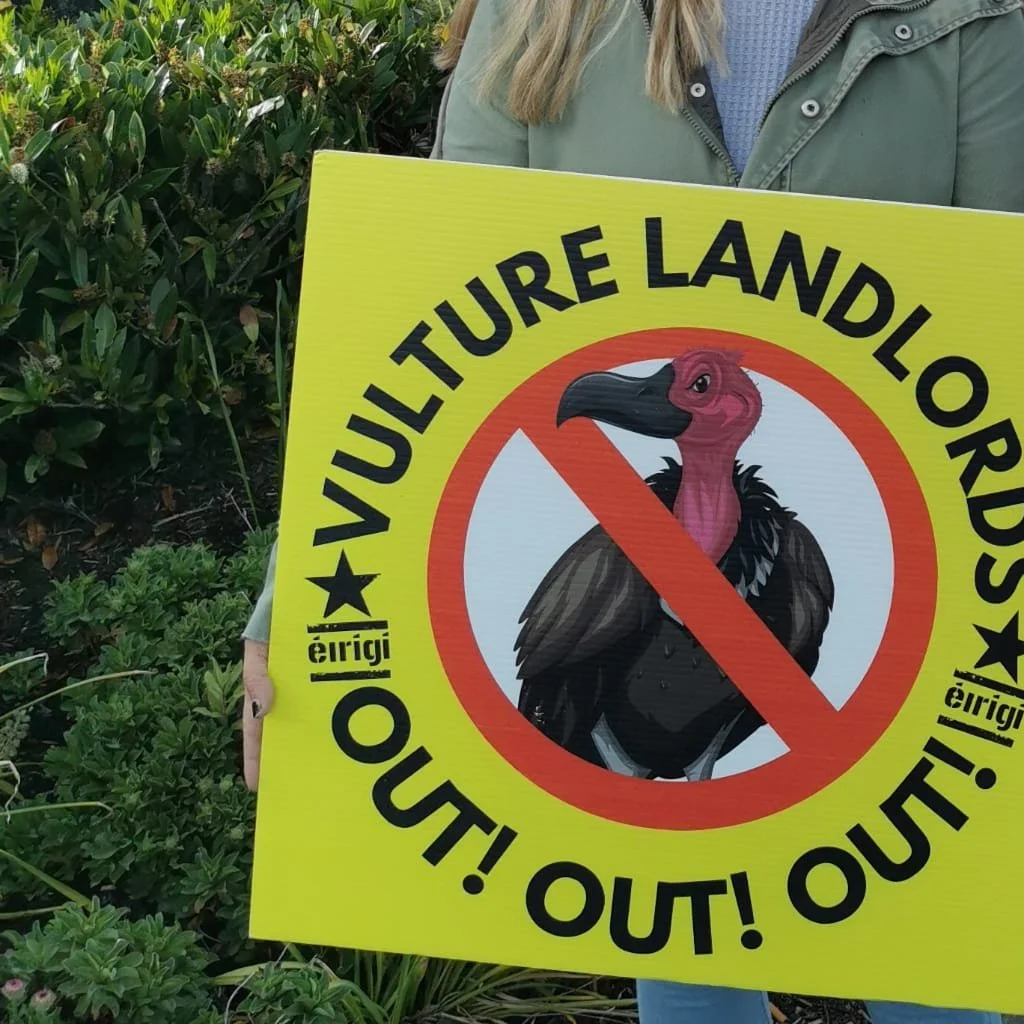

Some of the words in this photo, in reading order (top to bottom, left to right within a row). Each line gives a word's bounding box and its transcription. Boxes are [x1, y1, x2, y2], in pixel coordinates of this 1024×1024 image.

[312, 225, 620, 547] VULTURE
[331, 686, 518, 896] OUT!
[525, 861, 763, 955] OUT!
[787, 736, 998, 925] OUT!
